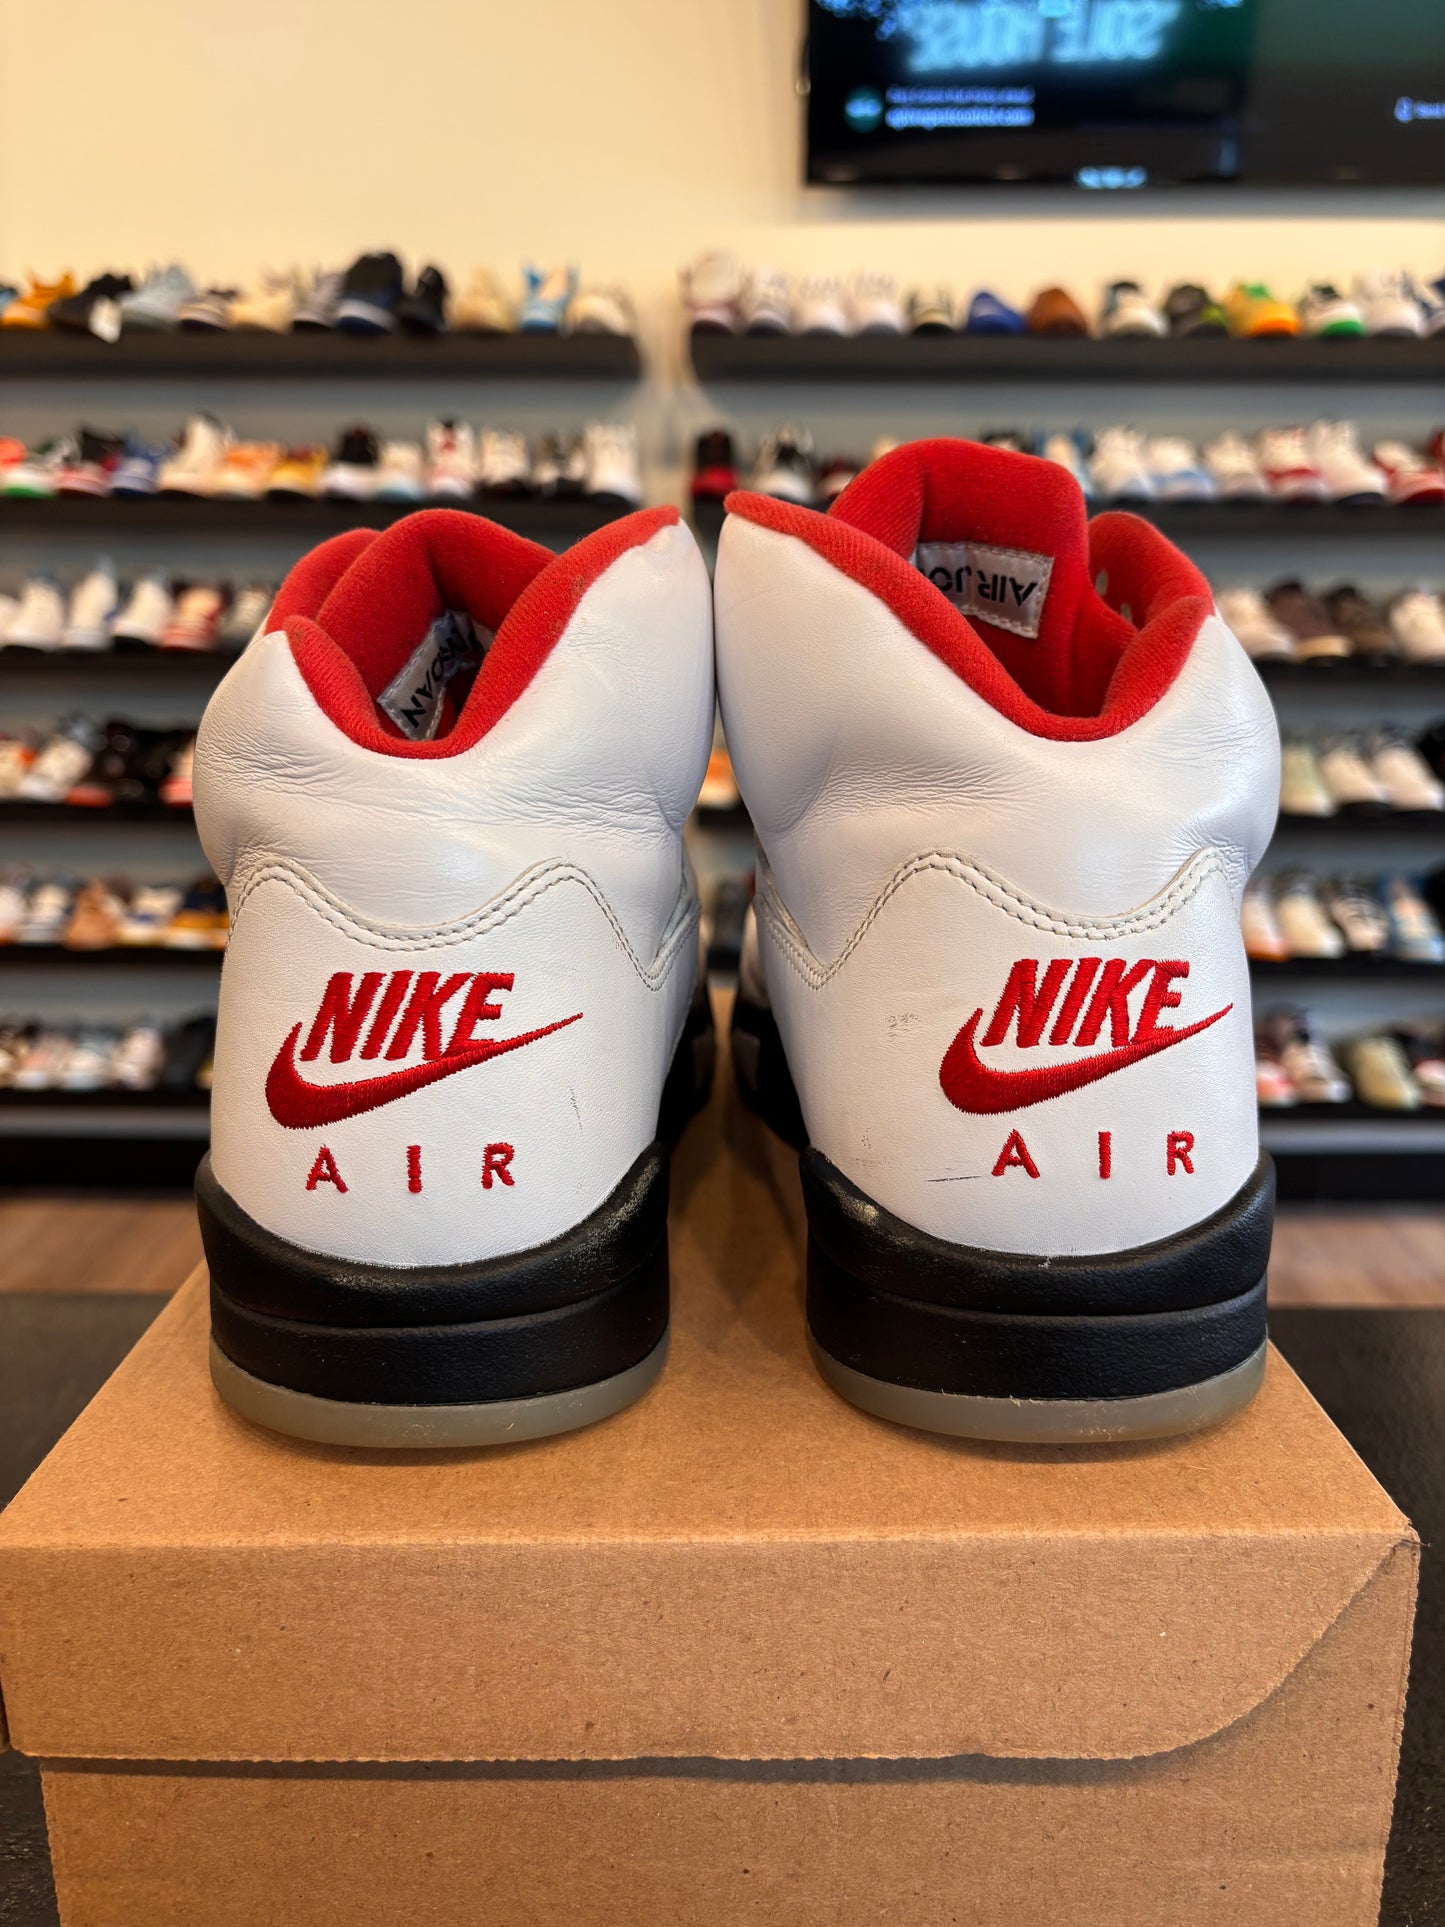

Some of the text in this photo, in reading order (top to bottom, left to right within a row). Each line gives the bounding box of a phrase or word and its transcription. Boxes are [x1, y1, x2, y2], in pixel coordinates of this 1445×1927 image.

[921, 565, 1038, 607] AIR JO
[300, 969, 515, 1063] NIKE
[980, 957, 1190, 1048] NIKE
[305, 1142, 516, 1194] AIR
[991, 1128, 1194, 1179] AIR
